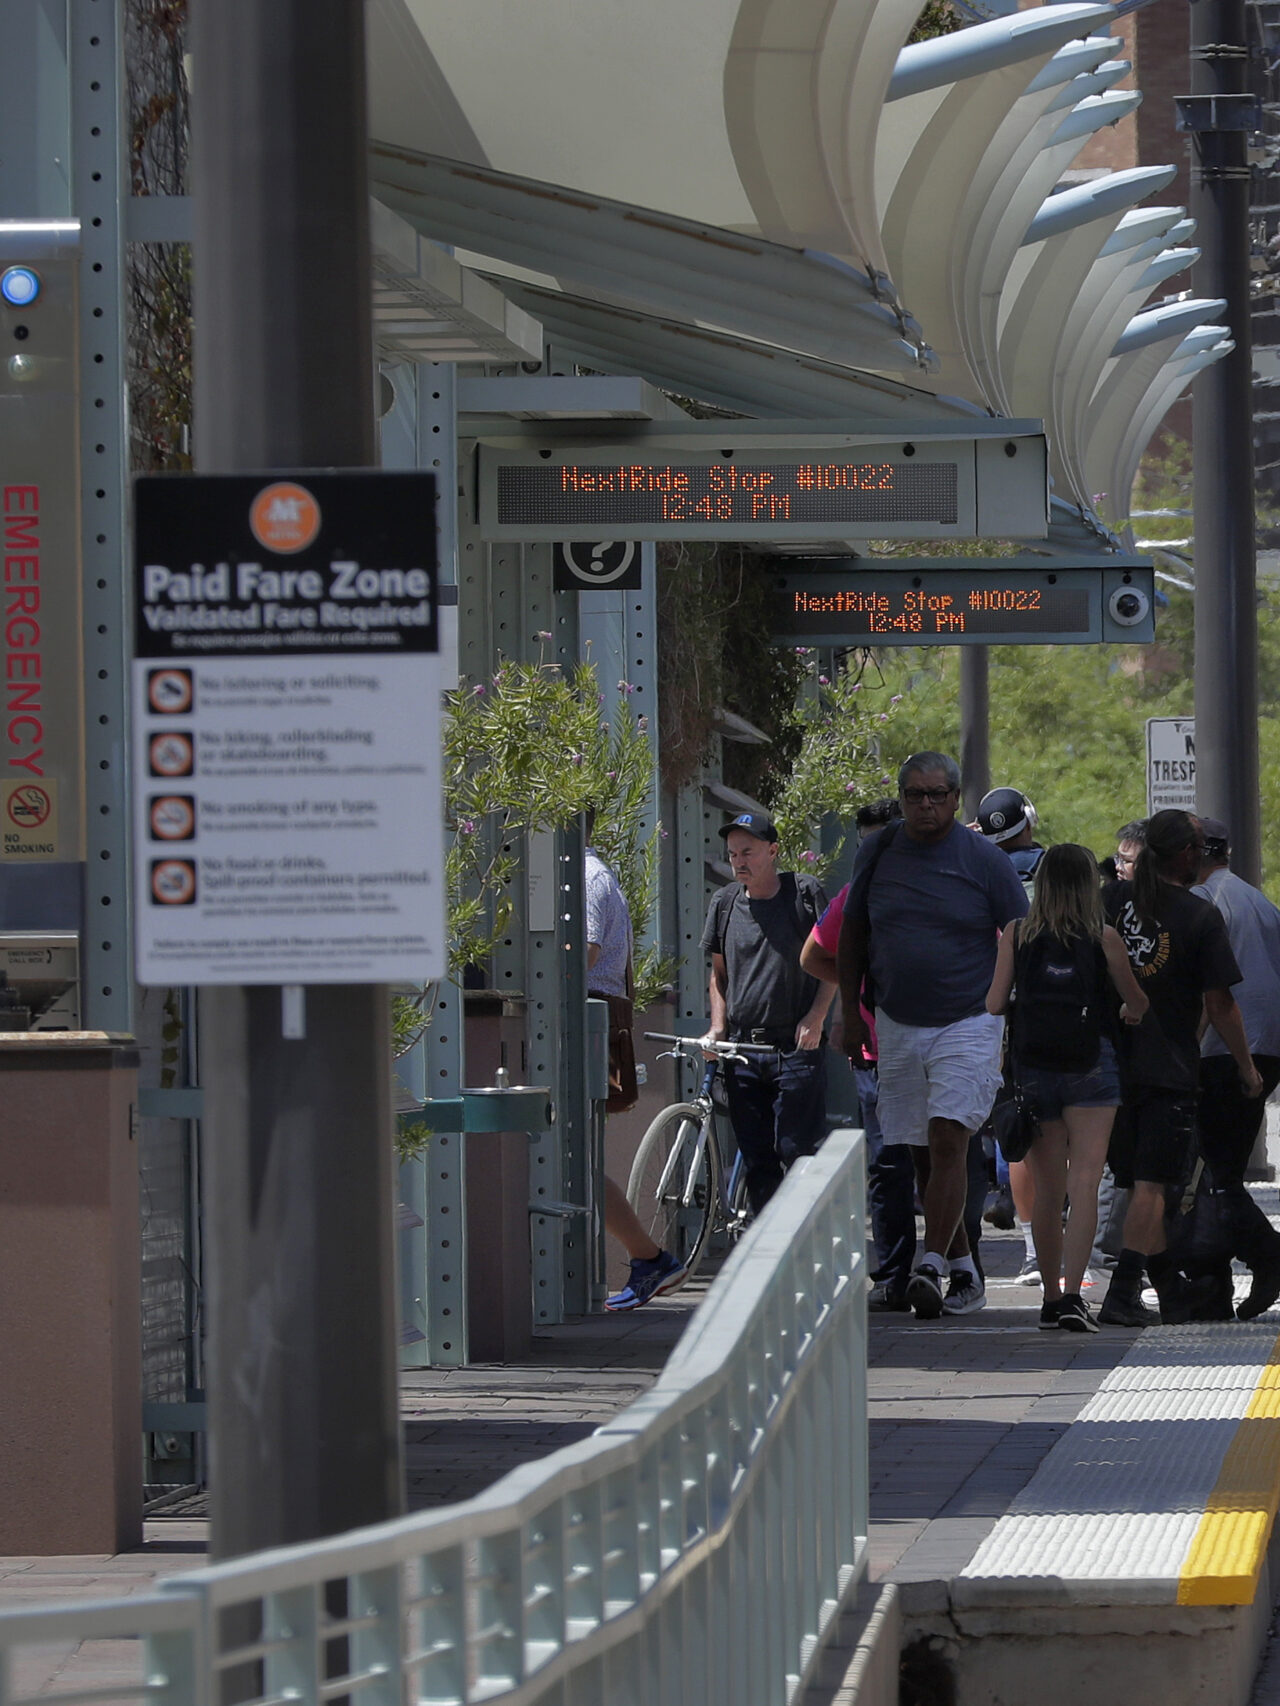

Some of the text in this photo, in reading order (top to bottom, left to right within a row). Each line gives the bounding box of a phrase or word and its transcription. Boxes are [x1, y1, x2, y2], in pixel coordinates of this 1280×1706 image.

[561, 463, 894, 492] NextRide Stop #10022
[662, 493, 791, 520] 12:48 PM
[144, 561, 430, 601] Paid Fare Zone
[795, 589, 1042, 612] NextRide Stop #10022
[143, 600, 430, 631] Validated Fare Required
[869, 612, 965, 632] 12:48 PM
[4, 485, 44, 777] EMERGENCY
[4, 834, 20, 843] NO
[4, 844, 54, 854] SMOKING
